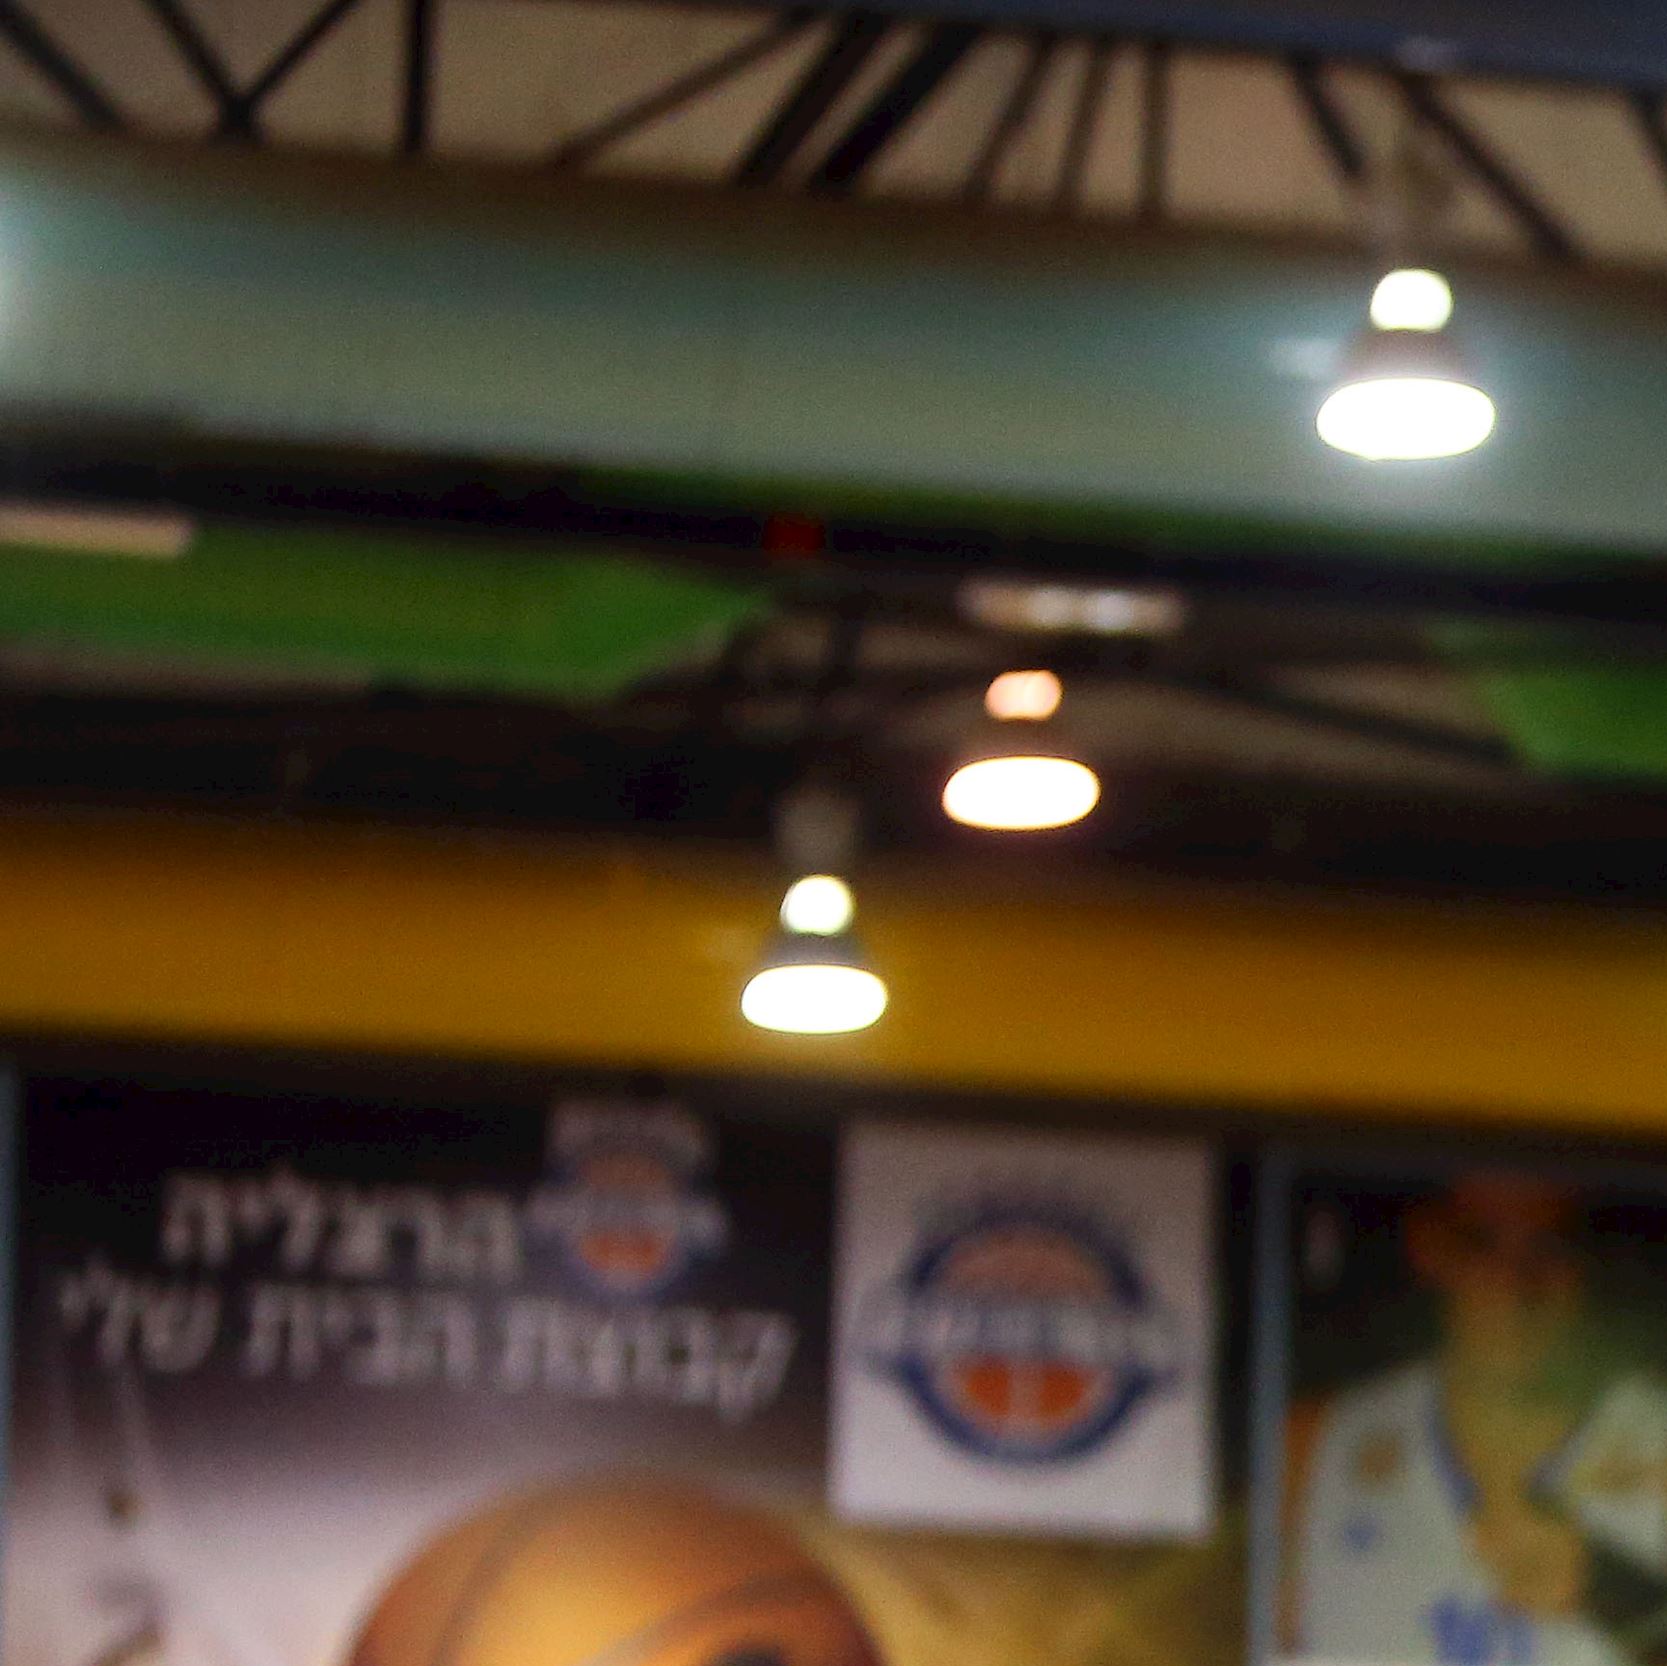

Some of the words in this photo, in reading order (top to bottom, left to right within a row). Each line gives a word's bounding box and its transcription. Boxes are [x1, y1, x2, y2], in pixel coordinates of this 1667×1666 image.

[162, 1162, 520, 1277] הרצליה
[58, 1258, 218, 1374] שלי
[246, 1281, 476, 1386] הבית
[496, 1289, 798, 1420] קבוצת
